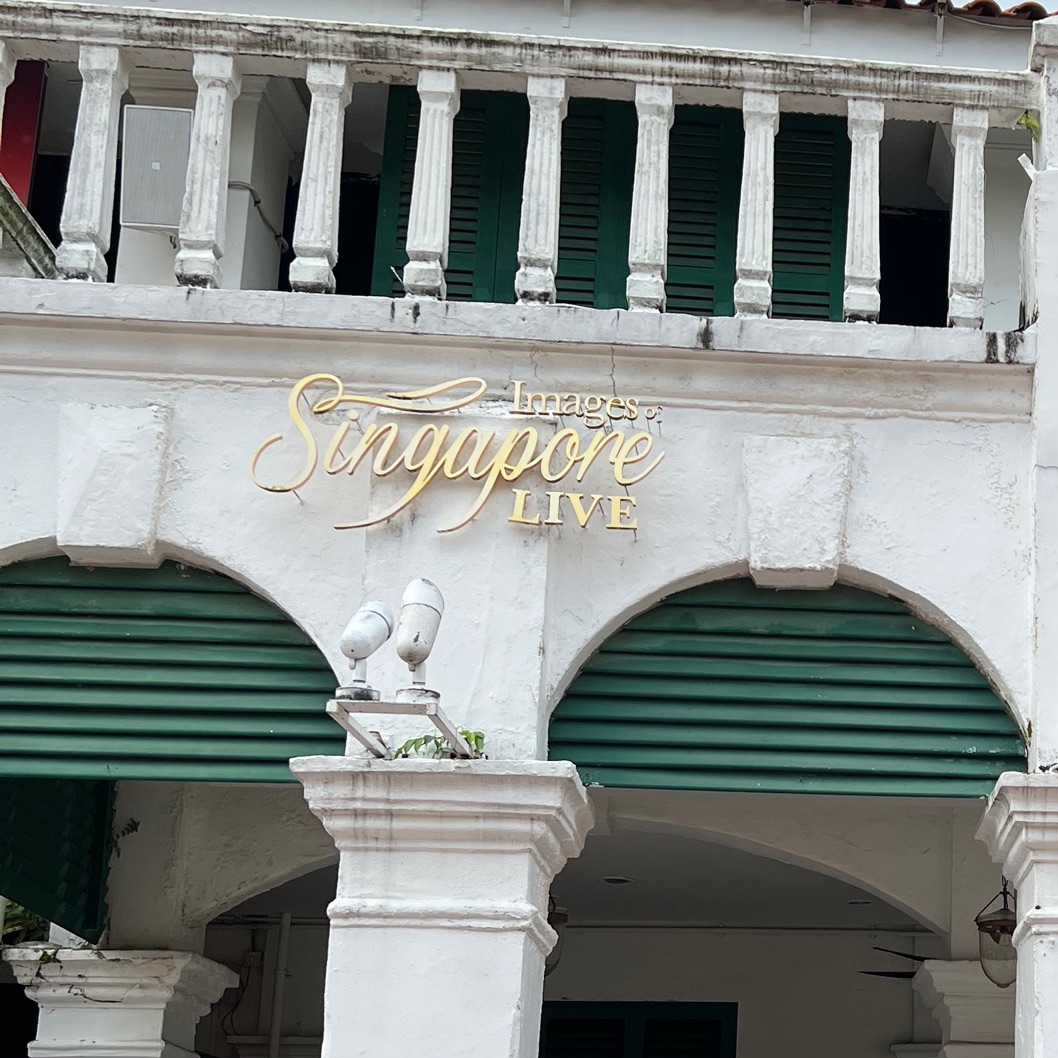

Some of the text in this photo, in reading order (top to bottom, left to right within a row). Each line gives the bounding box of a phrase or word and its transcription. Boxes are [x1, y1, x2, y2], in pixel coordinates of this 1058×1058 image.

[508, 379, 640, 428] Images
[249, 373, 665, 534] Singapore
[506, 487, 639, 531] LIVE
